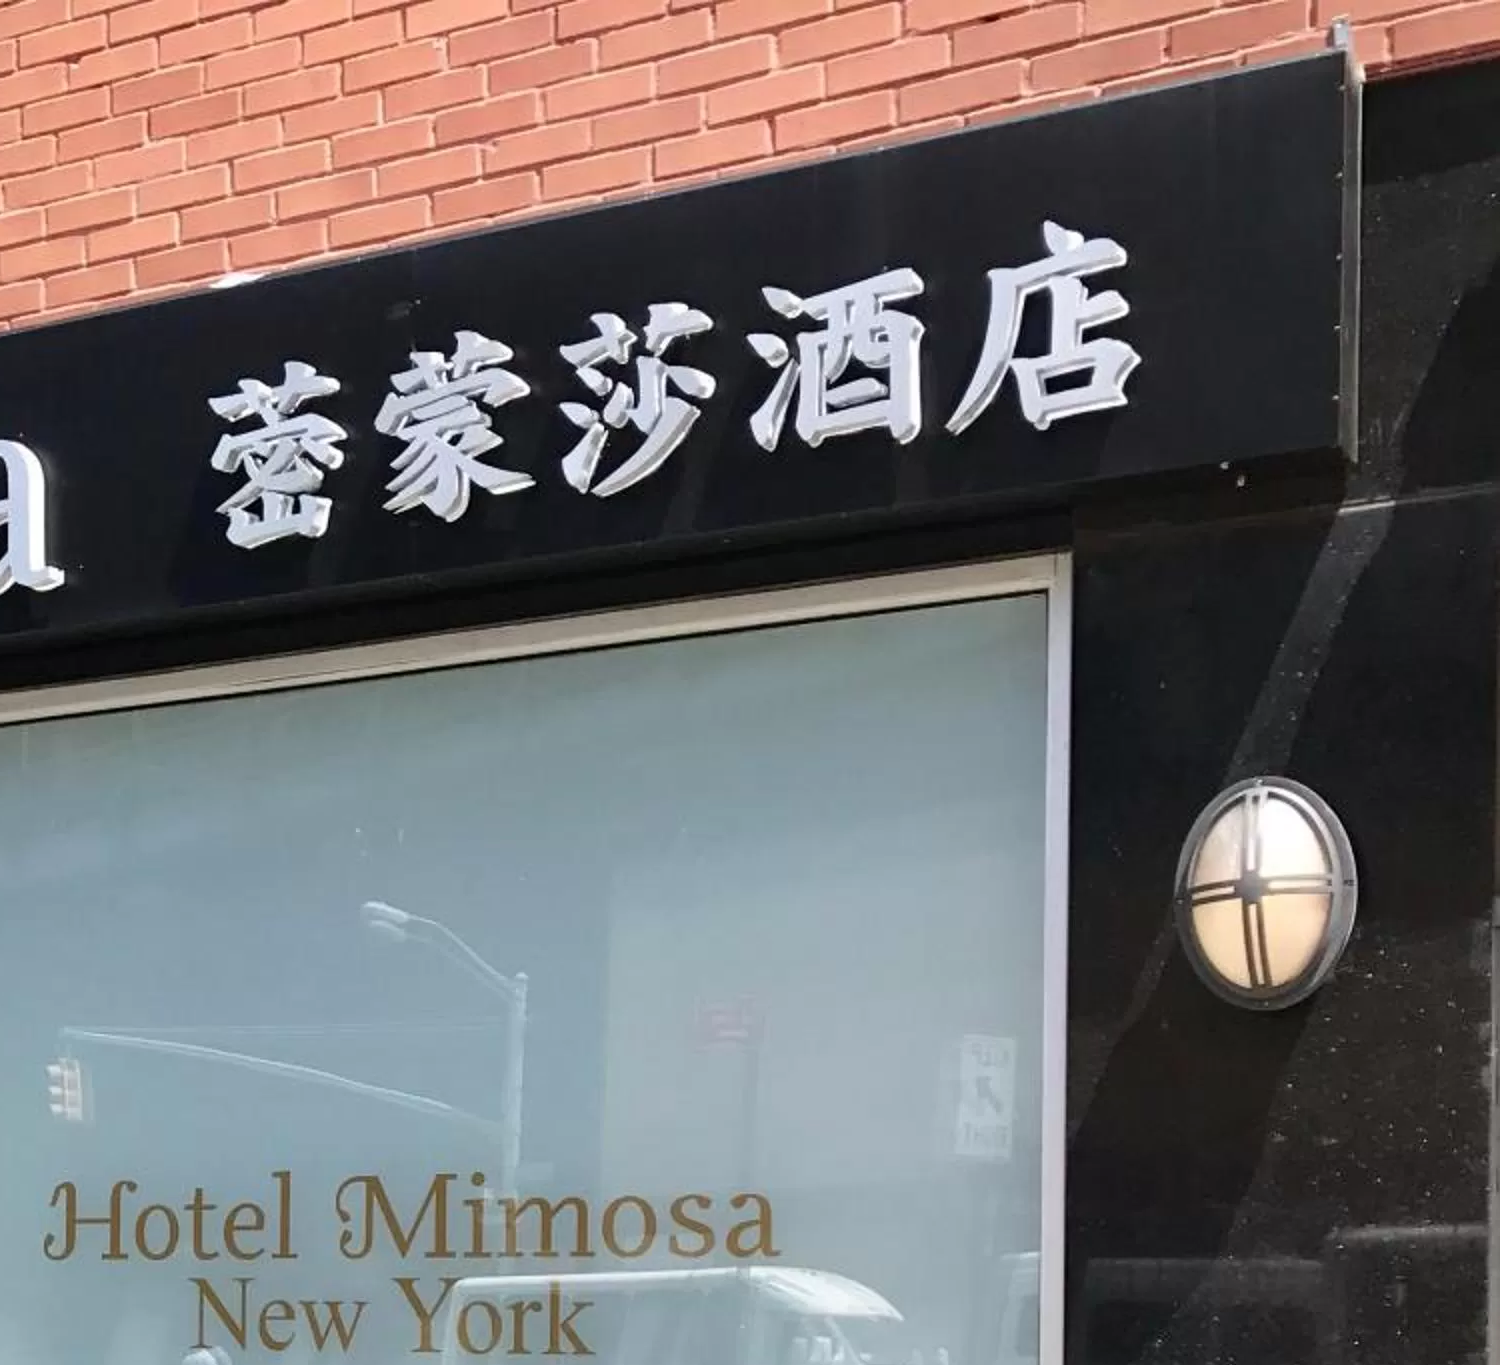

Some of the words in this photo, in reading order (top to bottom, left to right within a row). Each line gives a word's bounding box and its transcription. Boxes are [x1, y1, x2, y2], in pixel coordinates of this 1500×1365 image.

[43, 1170, 298, 1262] Hotel
[335, 1173, 783, 1260] Mimosa
[192, 1277, 368, 1354] New
[391, 1276, 599, 1356] York
